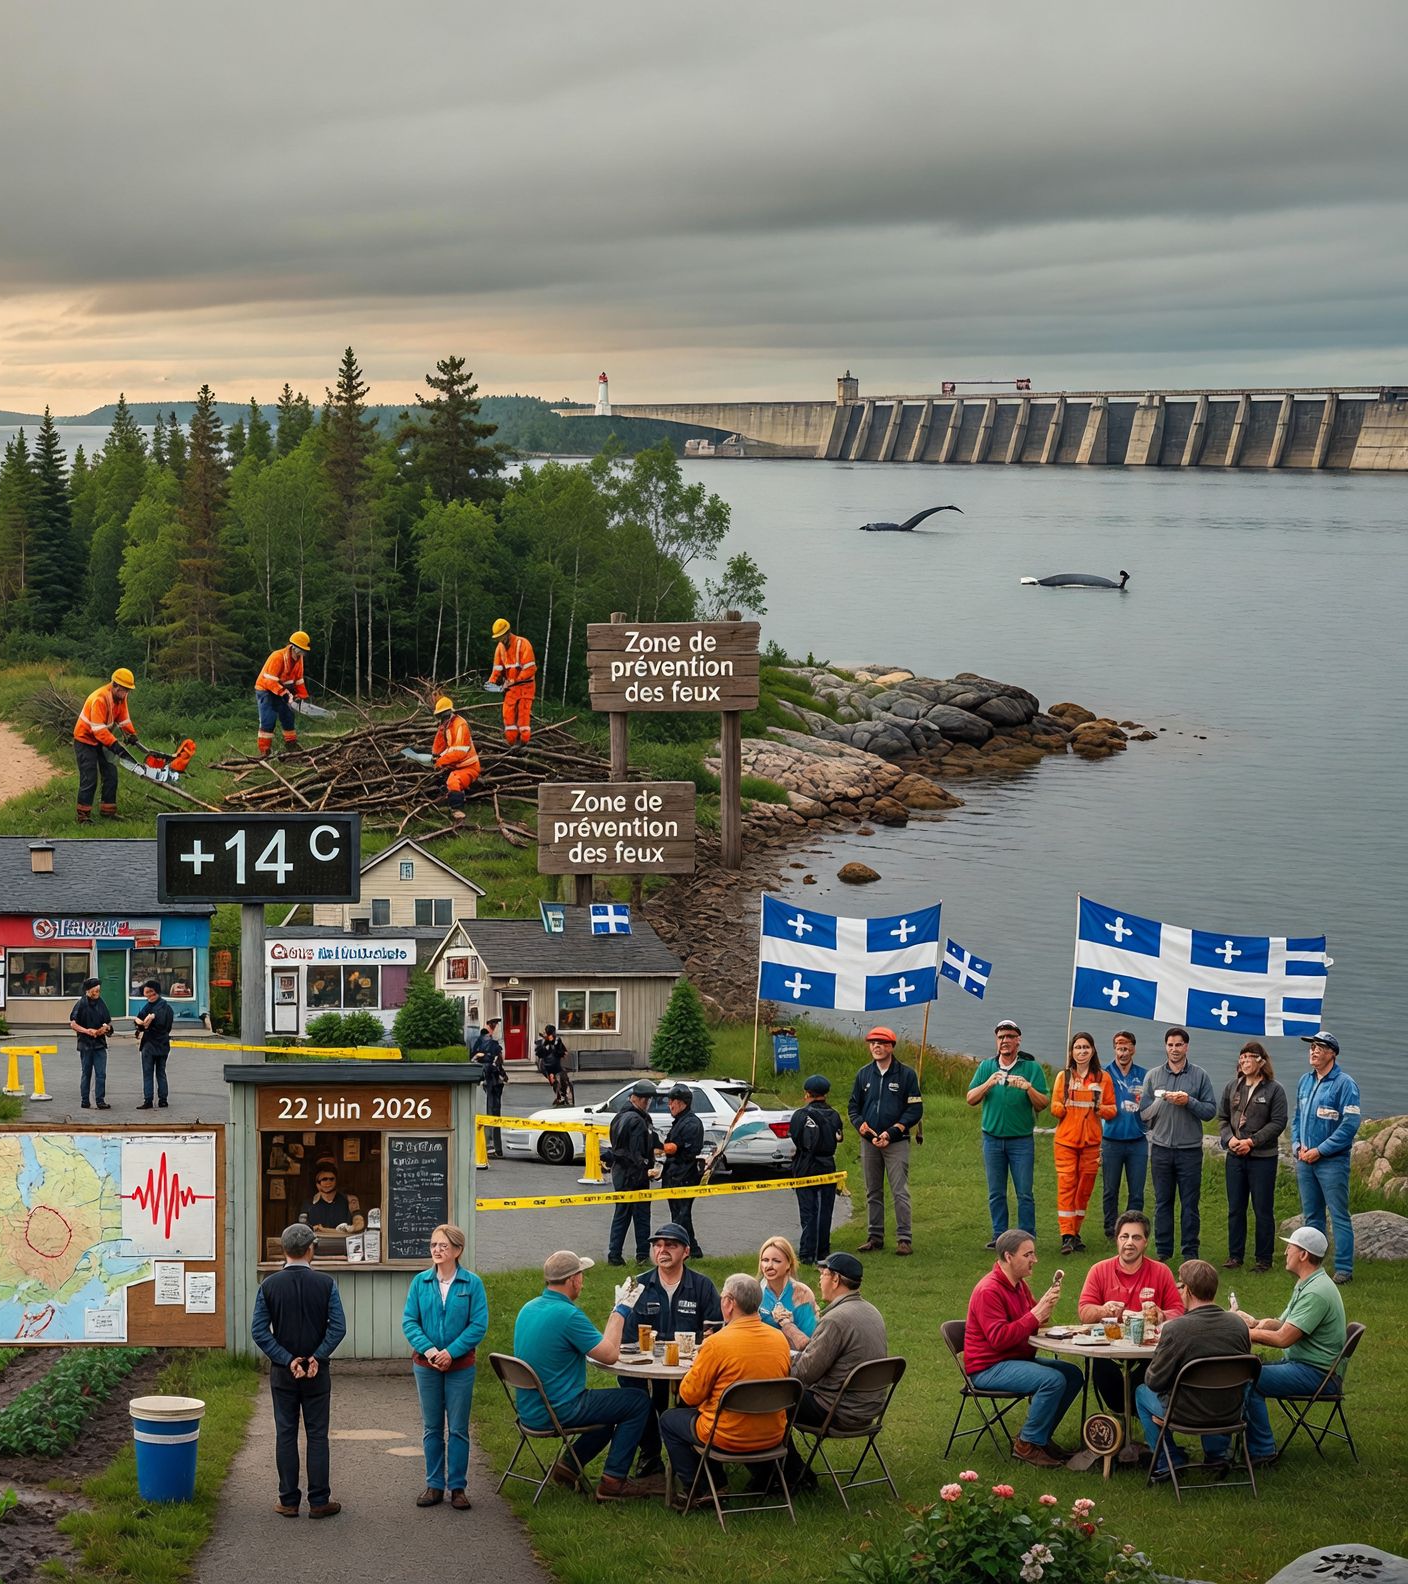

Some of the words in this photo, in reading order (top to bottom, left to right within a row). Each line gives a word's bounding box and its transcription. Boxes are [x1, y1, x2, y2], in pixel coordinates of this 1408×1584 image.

[624, 631, 681, 654] Zone
[689, 630, 717, 653] de
[611, 654, 733, 682] prévention
[625, 681, 664, 703] des
[671, 680, 721, 703] feux
[570, 790, 626, 813] Zone
[634, 789, 663, 812] de
[554, 816, 678, 844] prévention
[180, 829, 294, 884] +14
[309, 825, 340, 862] C
[568, 841, 607, 863] des
[614, 840, 664, 864] feux
[278, 1097, 308, 1119] 22
[314, 1097, 360, 1125] juin
[371, 1097, 432, 1120] 2026
